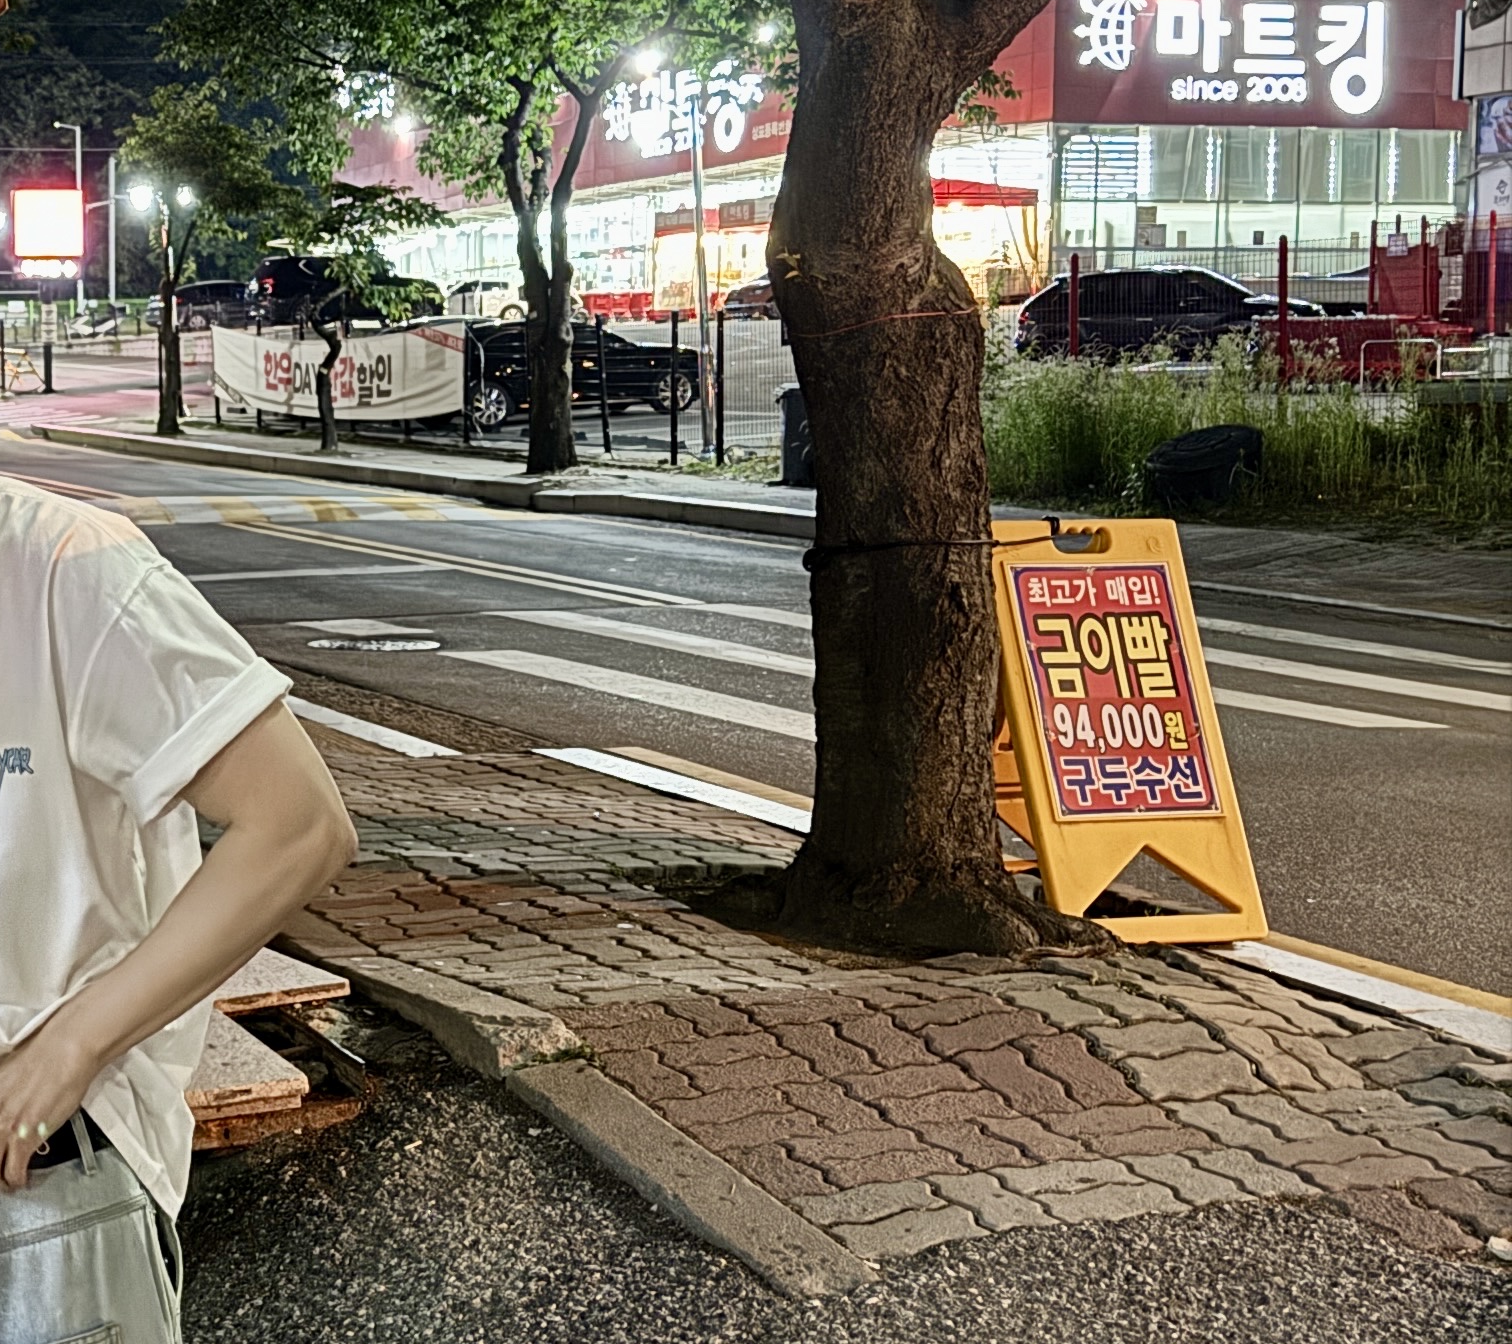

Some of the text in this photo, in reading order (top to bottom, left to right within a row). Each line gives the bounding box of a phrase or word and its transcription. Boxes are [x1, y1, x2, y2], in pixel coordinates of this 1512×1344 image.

[1170, 75, 1308, 103] since 2008
[1027, 575, 1162, 607] 최고가 매입!
[1035, 614, 1178, 699] 금이빨
[1062, 755, 1207, 805] 구두수선
